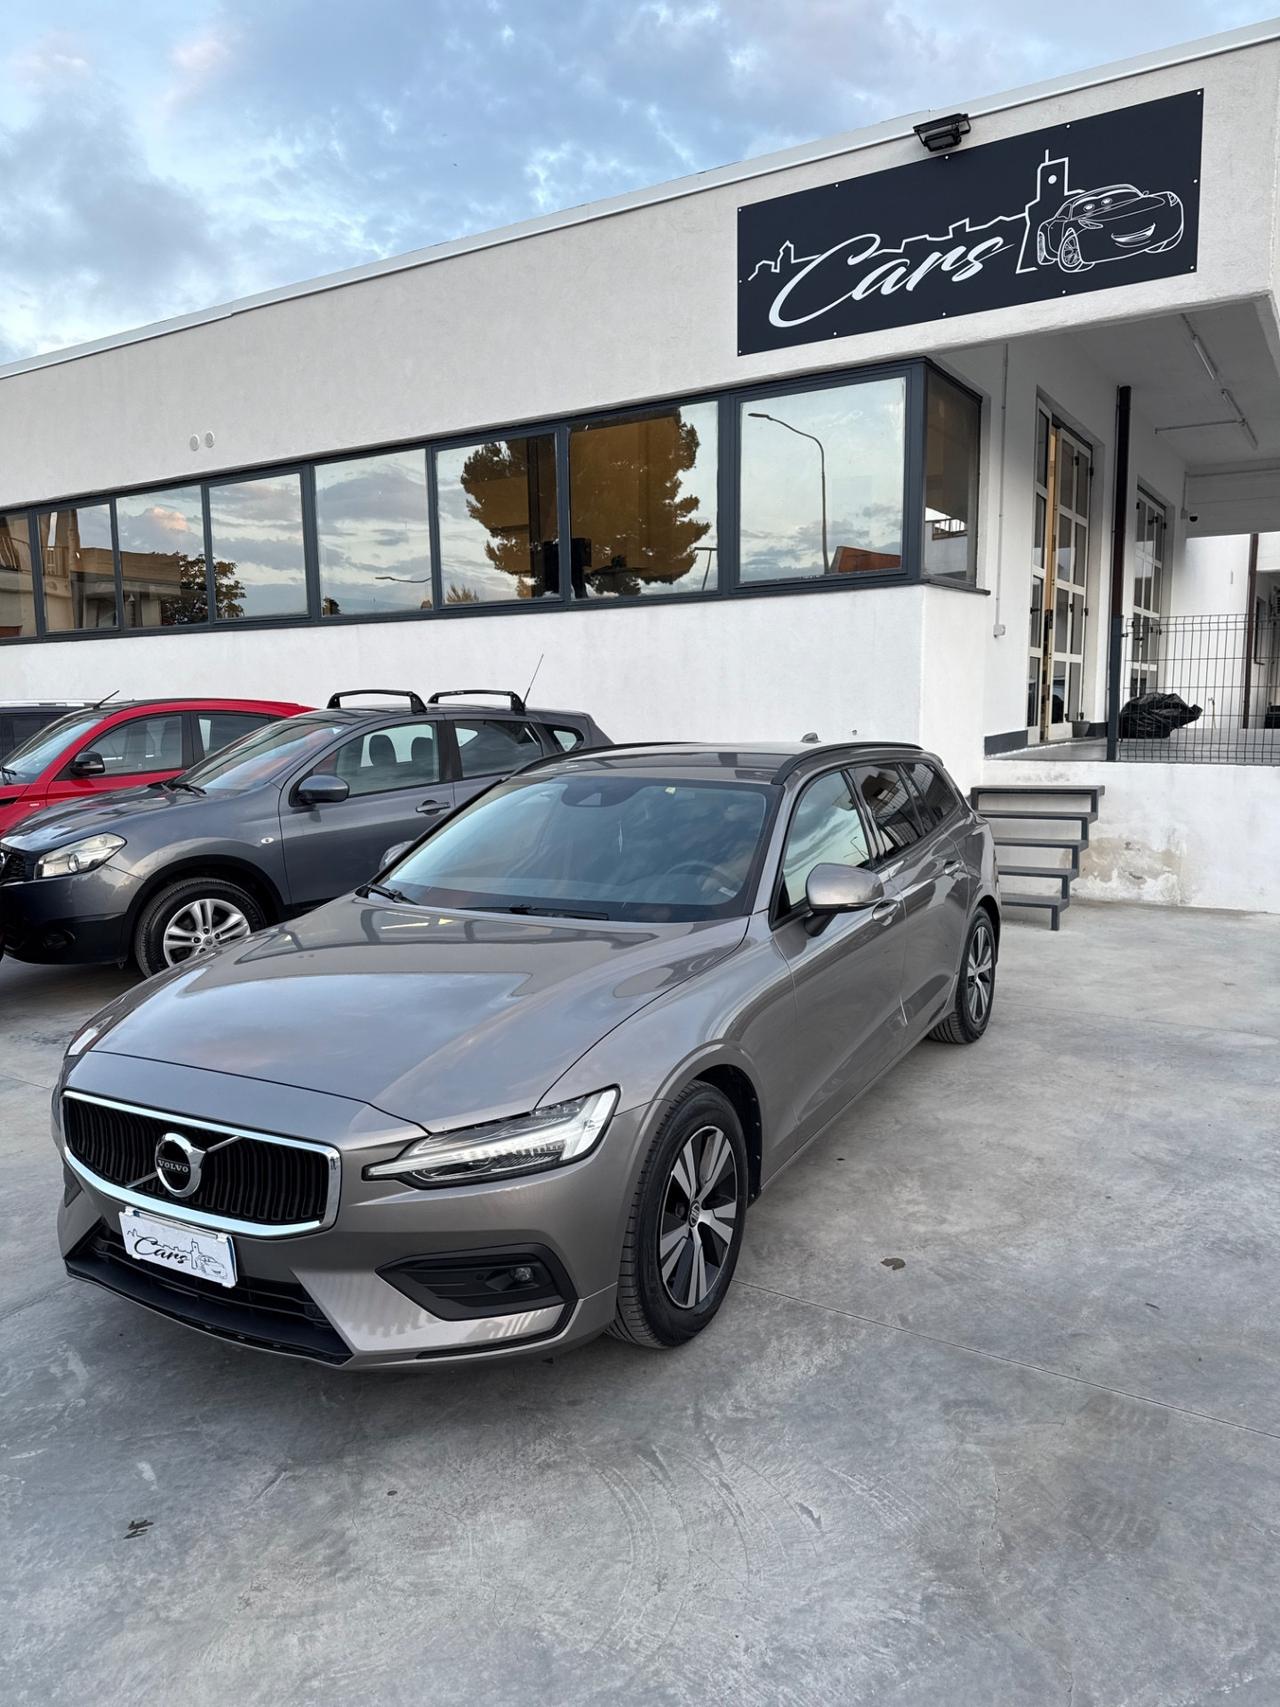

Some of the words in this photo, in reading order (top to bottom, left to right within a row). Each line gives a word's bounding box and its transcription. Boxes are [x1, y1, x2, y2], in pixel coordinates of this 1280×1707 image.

[768, 233, 1014, 327] Cars
[158, 1160, 189, 1173] VOLVO
[134, 1236, 189, 1264] Cars
